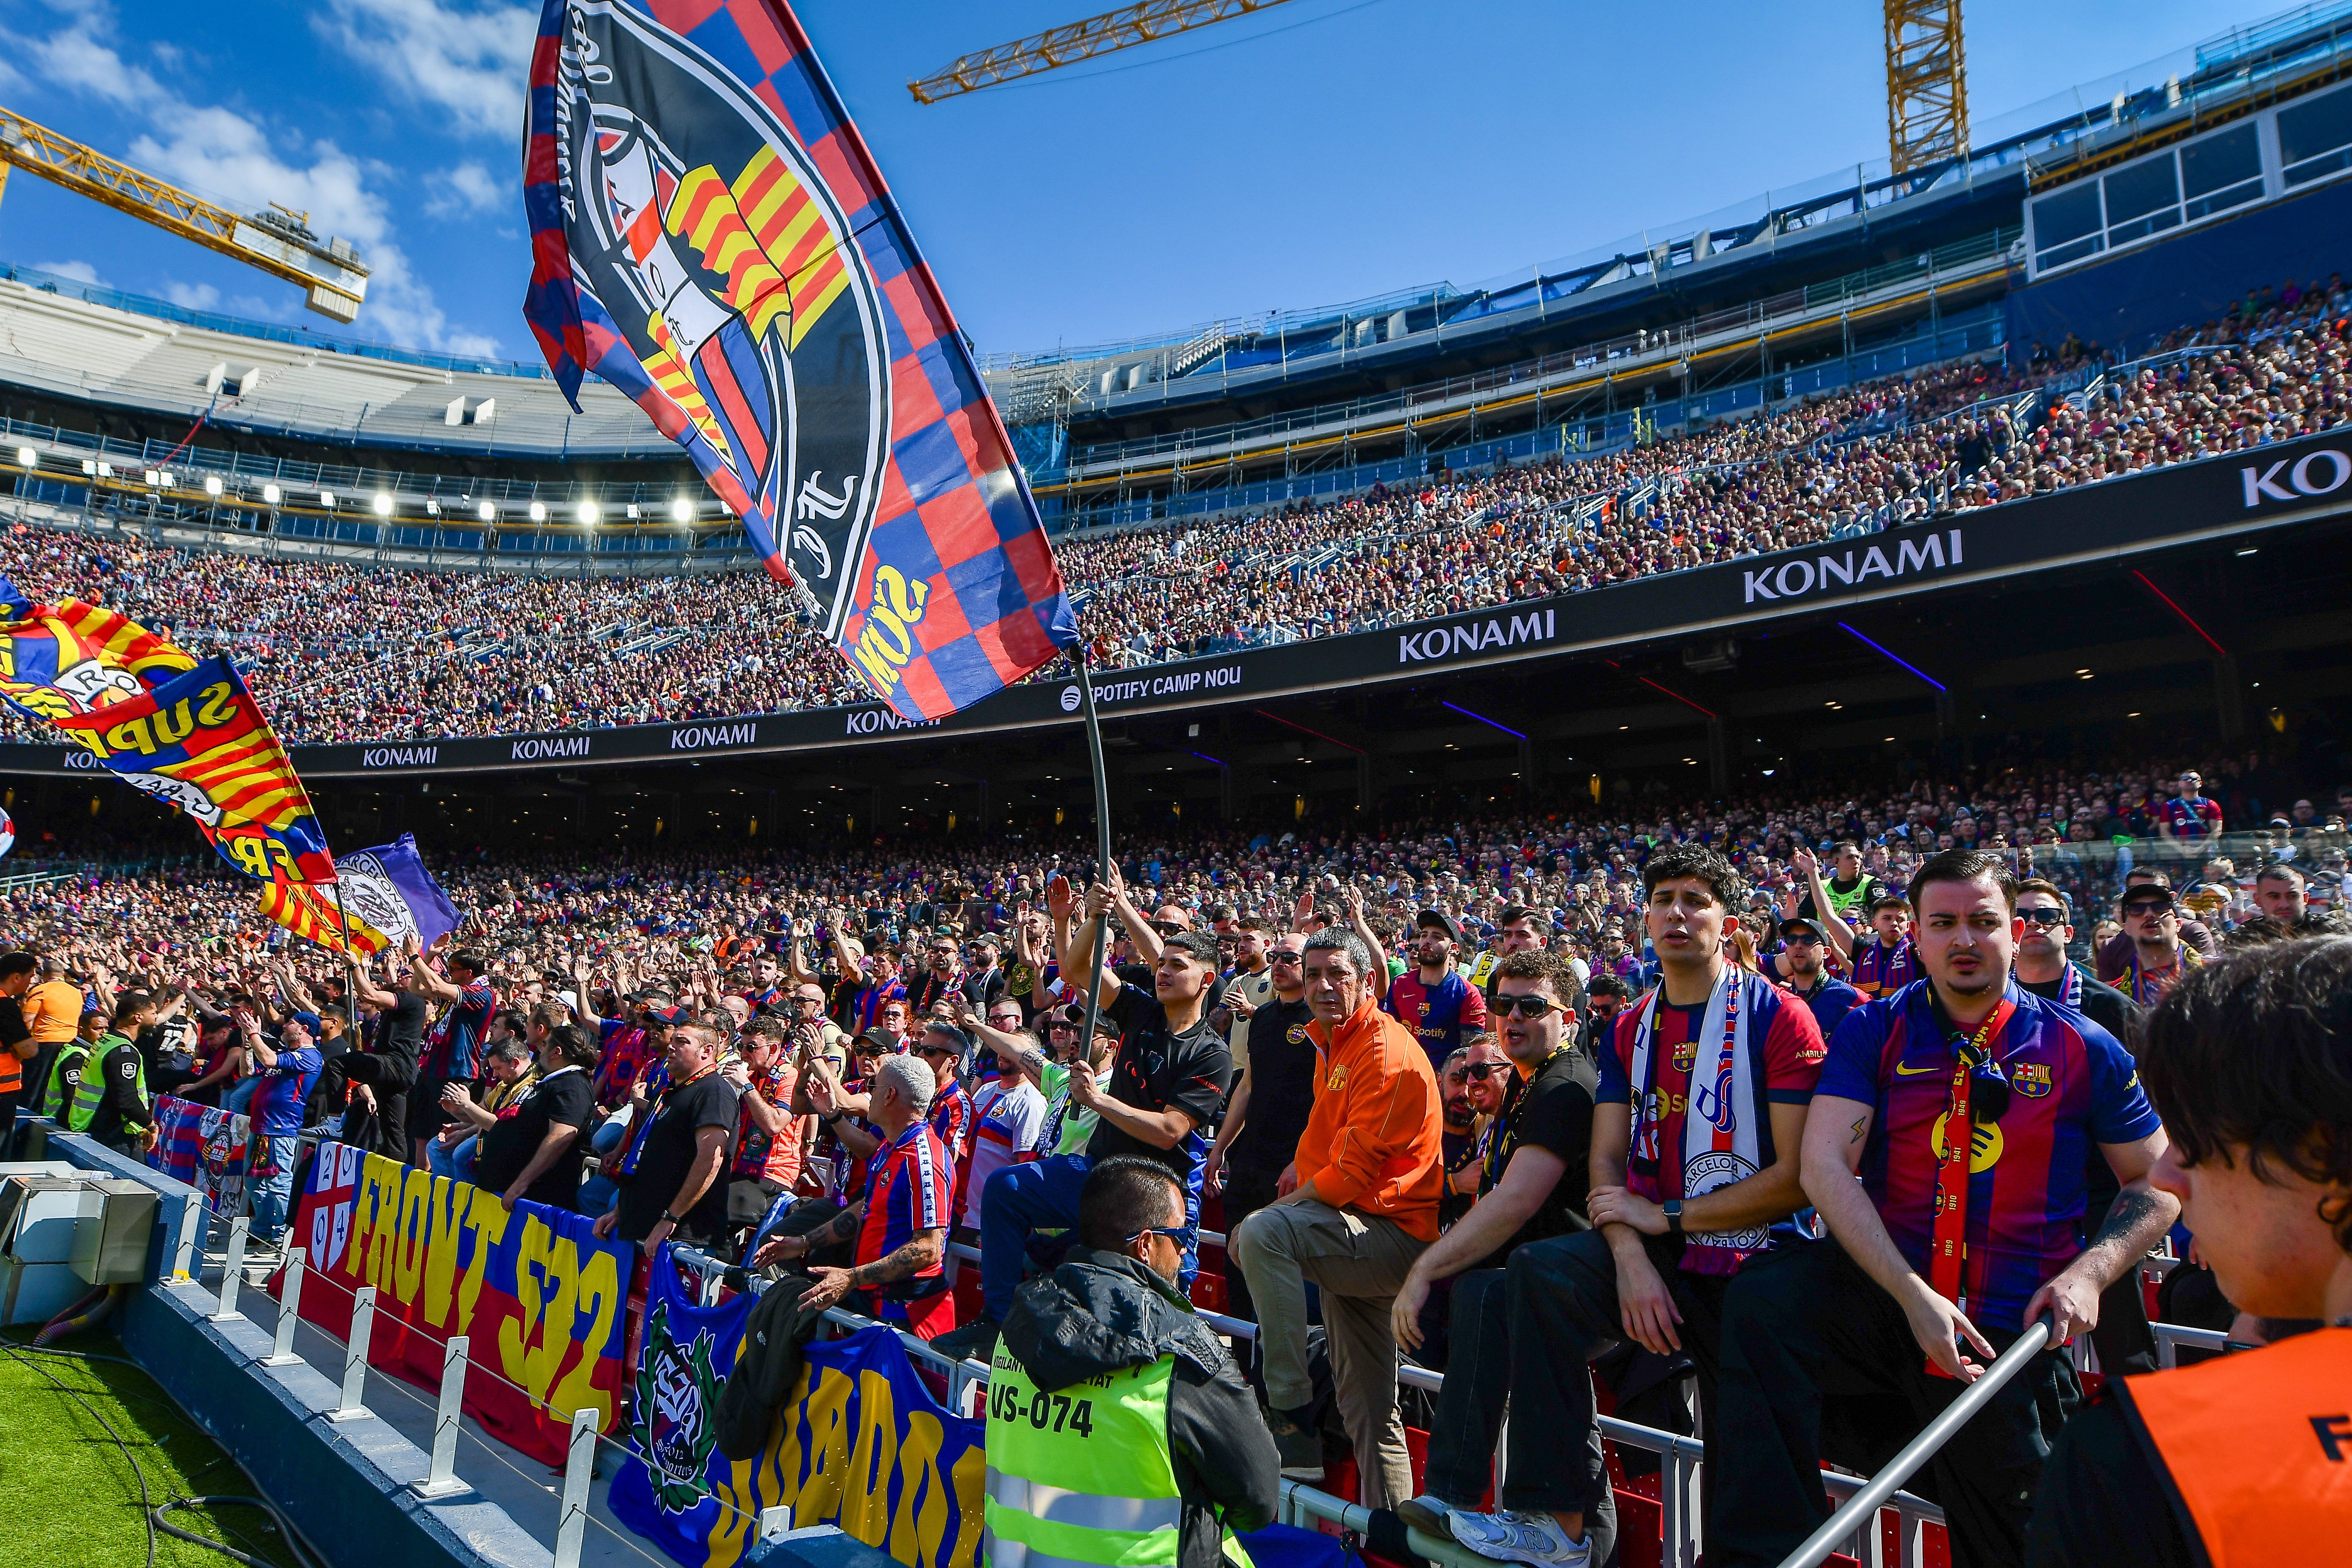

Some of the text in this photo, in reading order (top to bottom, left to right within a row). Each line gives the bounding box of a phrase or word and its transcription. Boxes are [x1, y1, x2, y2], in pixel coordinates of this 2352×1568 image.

[1743, 529, 1963, 604] KONAMI
[1399, 609, 1555, 663] KONAMI
[1091, 666, 1241, 703] POTIFY CAMP NOU
[512, 737, 591, 759] KONAMI
[671, 723, 757, 749] KONAMI
[363, 746, 438, 766] KONAMI
[1413, 1026, 1446, 1039] Spotify
[1957, 1100, 1966, 1116] 1949
[1953, 1146, 1962, 1162] 1941
[1948, 1195, 1957, 1211] 1910
[346, 1152, 511, 1337] FRONT
[1944, 1239, 1953, 1256] 1899
[498, 1212, 618, 1435] 532
[991, 1382, 1093, 1438] VS-074
